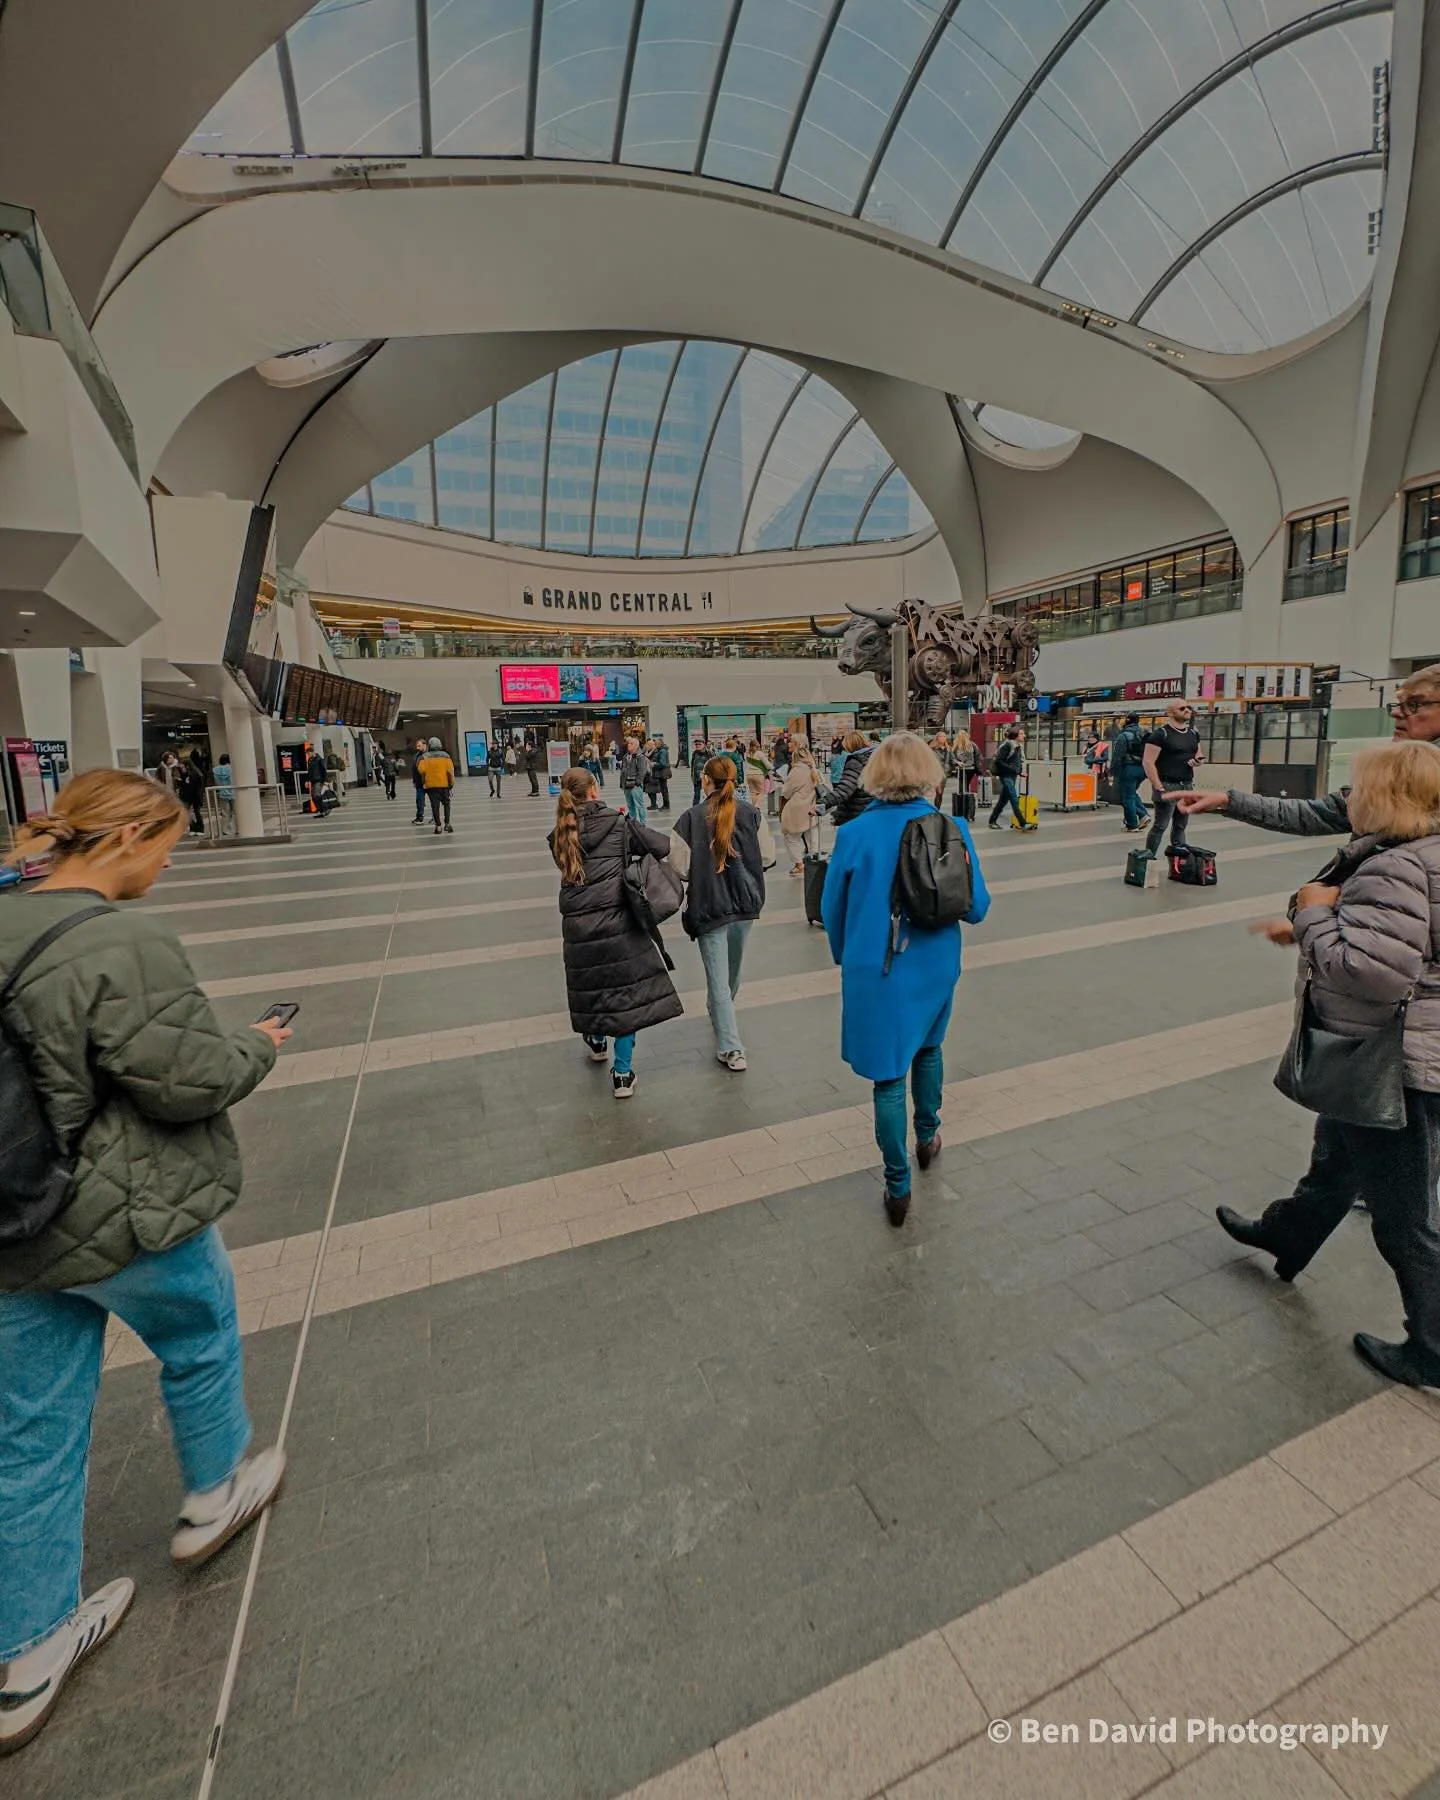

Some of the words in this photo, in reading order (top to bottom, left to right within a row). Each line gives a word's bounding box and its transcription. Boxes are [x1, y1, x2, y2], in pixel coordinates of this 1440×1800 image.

[542, 587, 602, 611] GRAND
[610, 592, 693, 612] CENTRAL
[1145, 681, 1162, 695] PRET
[1163, 681, 1169, 694] A
[33, 743, 65, 752] Tickets
